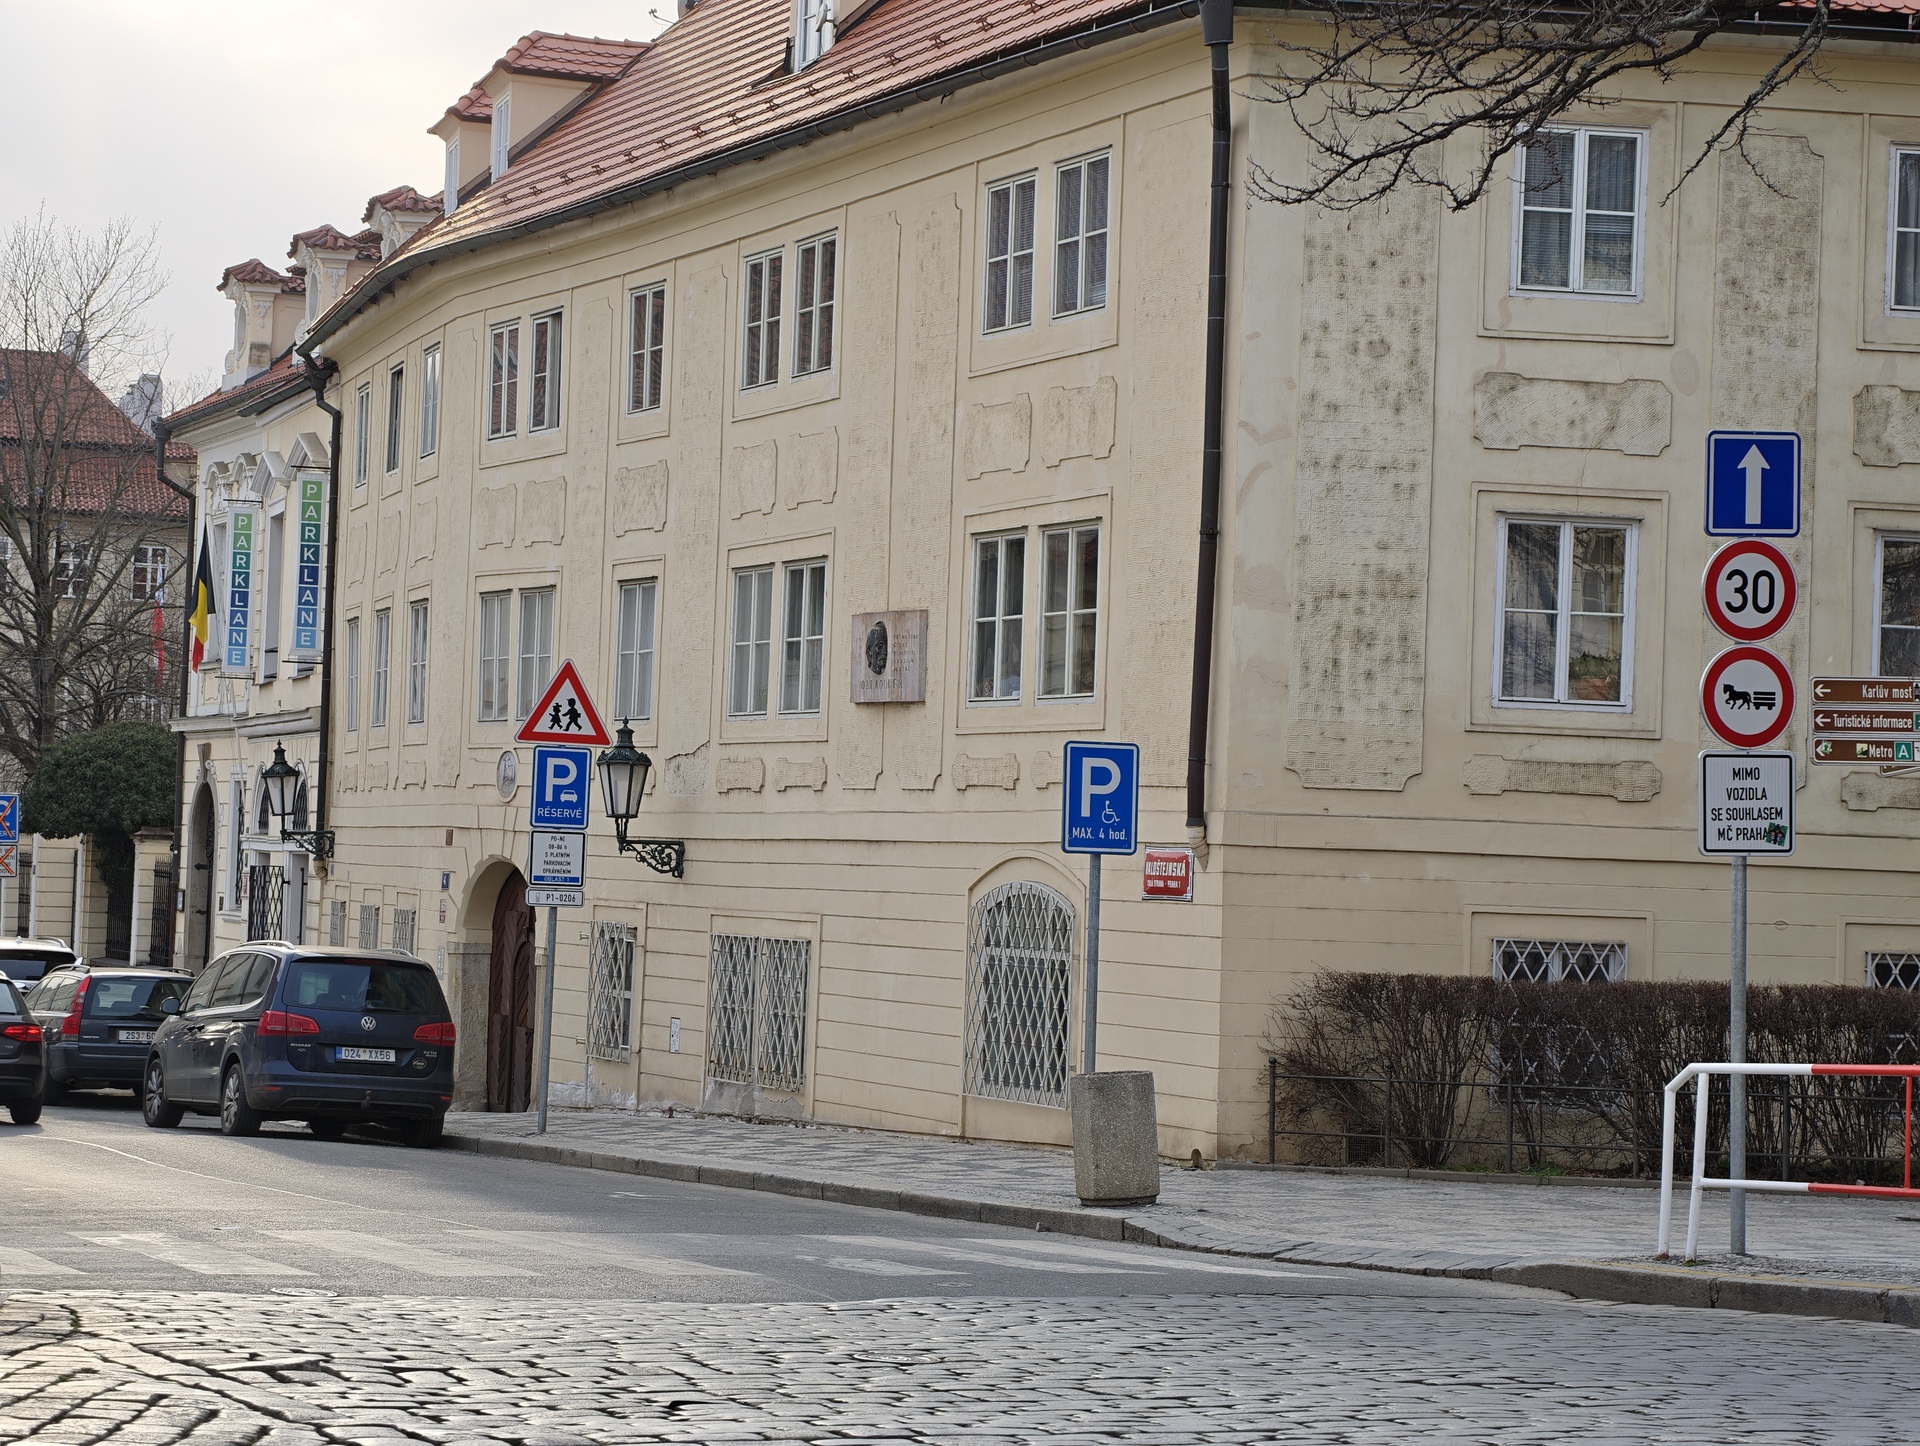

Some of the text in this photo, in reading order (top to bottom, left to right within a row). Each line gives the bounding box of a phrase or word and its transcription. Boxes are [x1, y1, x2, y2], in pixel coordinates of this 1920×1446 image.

[300, 484, 318, 645] PARKLANE
[231, 516, 249, 663] PARKLANE
[1725, 569, 1775, 614] 30
[1862, 684, 1913, 699] Karlův most
[1833, 713, 1913, 729] Turistické informace
[1868, 744, 1909, 758] Metro A
[545, 757, 578, 802] P
[1732, 767, 1760, 781] MIMO
[1081, 757, 1122, 817] P
[1726, 787, 1768, 801] VOZIDLA
[537, 805, 583, 819] RÉSERVÉ
[1711, 806, 1784, 822] SE SOUHLASEM
[1072, 826, 1128, 840] MAX. 4 hod.
[1717, 824, 1733, 841] MČ
[546, 893, 576, 902] P1-0206
[125, 1031, 141, 1040] 2S3
[344, 1048, 391, 1061] 024 XX56
